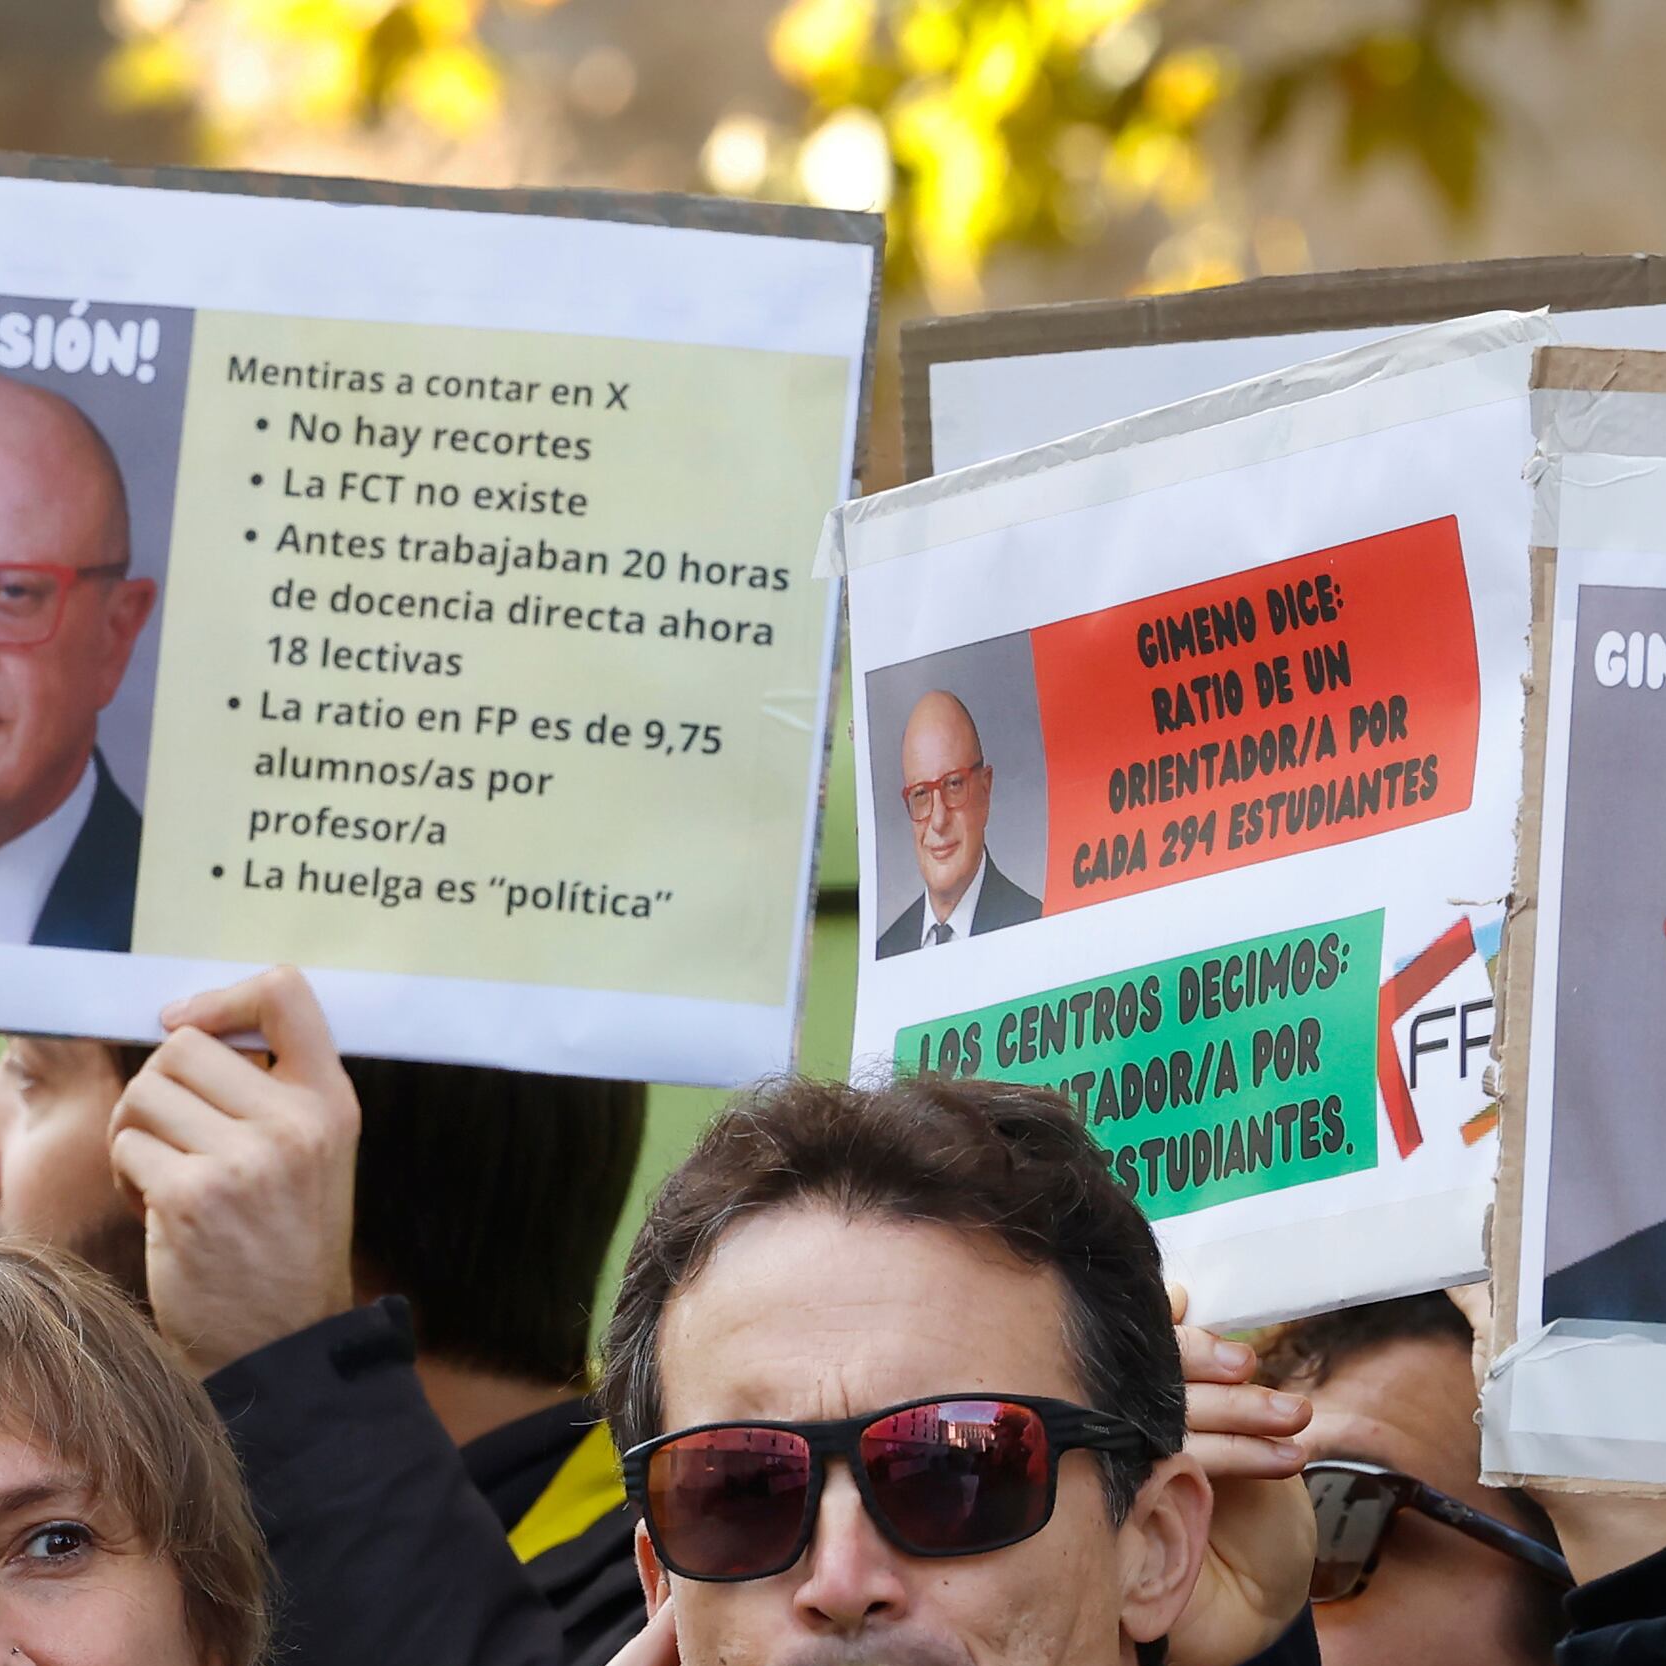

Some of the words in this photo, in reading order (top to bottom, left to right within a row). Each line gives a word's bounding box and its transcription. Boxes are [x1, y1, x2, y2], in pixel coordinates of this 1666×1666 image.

[228, 356, 385, 394] Mentiras
[395, 370, 413, 395] a
[425, 373, 535, 404] contar
[551, 382, 592, 407] en
[605, 382, 630, 410] X
[288, 413, 341, 444] No
[355, 415, 421, 457] hay
[433, 425, 592, 460] recortes
[285, 469, 324, 498] La
[339, 472, 405, 504] FCT
[416, 481, 460, 507] no
[473, 482, 588, 516] existe
[275, 524, 386, 561] Antes
[398, 532, 609, 575] trabajaban
[623, 548, 665, 580] 20
[680, 552, 790, 592] horas
[271, 579, 317, 610] de
[330, 584, 494, 622] docencia
[508, 595, 645, 635] directa
[659, 610, 774, 646] ahora
[1137, 596, 1257, 669] GIMENO
[1267, 574, 1344, 635] DICE:
[267, 635, 307, 666] 18
[322, 638, 463, 676] lectivas
[1152, 669, 1243, 735] RATIO
[1254, 655, 1294, 709] DE
[1303, 640, 1352, 695] UN
[260, 691, 301, 722] La
[316, 698, 405, 730] ratio
[417, 708, 461, 733] en
[475, 706, 518, 736] FP
[531, 715, 571, 742] es
[585, 714, 631, 746] de
[643, 719, 722, 756] 9,75
[1108, 714, 1337, 814] ORIENTADOR/A
[1349, 695, 1408, 753] POR
[254, 747, 474, 791] alumnos/as
[487, 768, 553, 801] por
[249, 806, 447, 845] profesor/a
[1073, 828, 1147, 888] CADA
[1228, 754, 1438, 850] ESTUDIANTES
[244, 859, 285, 890] La
[298, 862, 422, 908] huelga
[436, 876, 477, 903] es
[996, 975, 1161, 1070] CENTROS
[1178, 931, 1350, 1026] DECIMOS:
[1251, 1016, 1322, 1090] POR
[1100, 1094, 1354, 1200] STUDIANTES.
